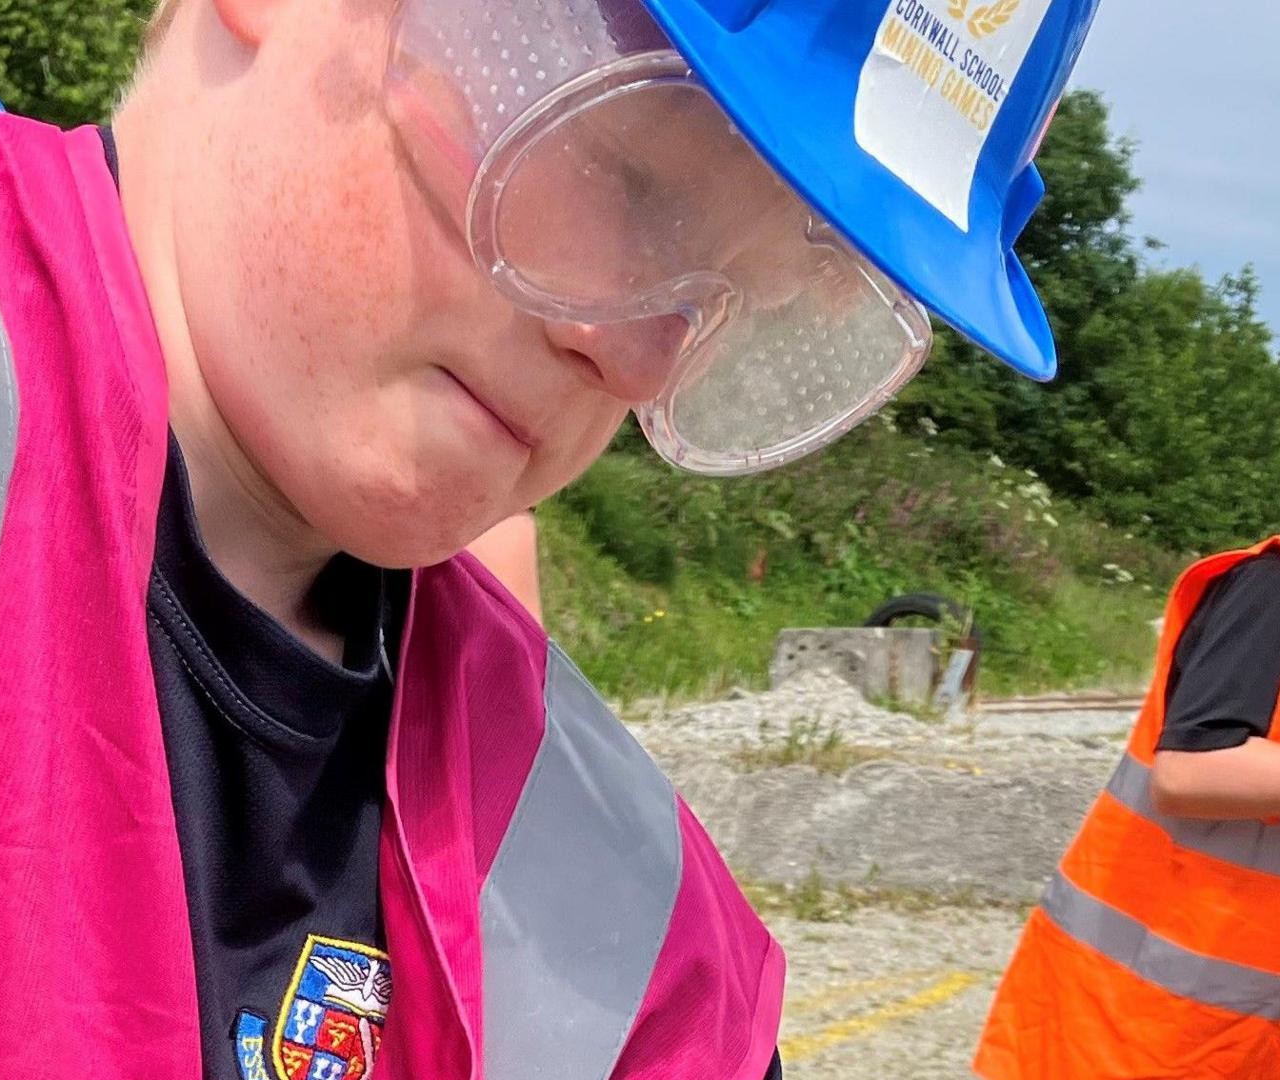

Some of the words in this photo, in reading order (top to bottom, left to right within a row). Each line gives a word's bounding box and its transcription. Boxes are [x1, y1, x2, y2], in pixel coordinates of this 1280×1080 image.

[882, 17, 943, 88] MINING
[940, 68, 994, 131] GAMES
[895, 0, 960, 63] CORNWALL
[959, 48, 1004, 102] SCHOOL
